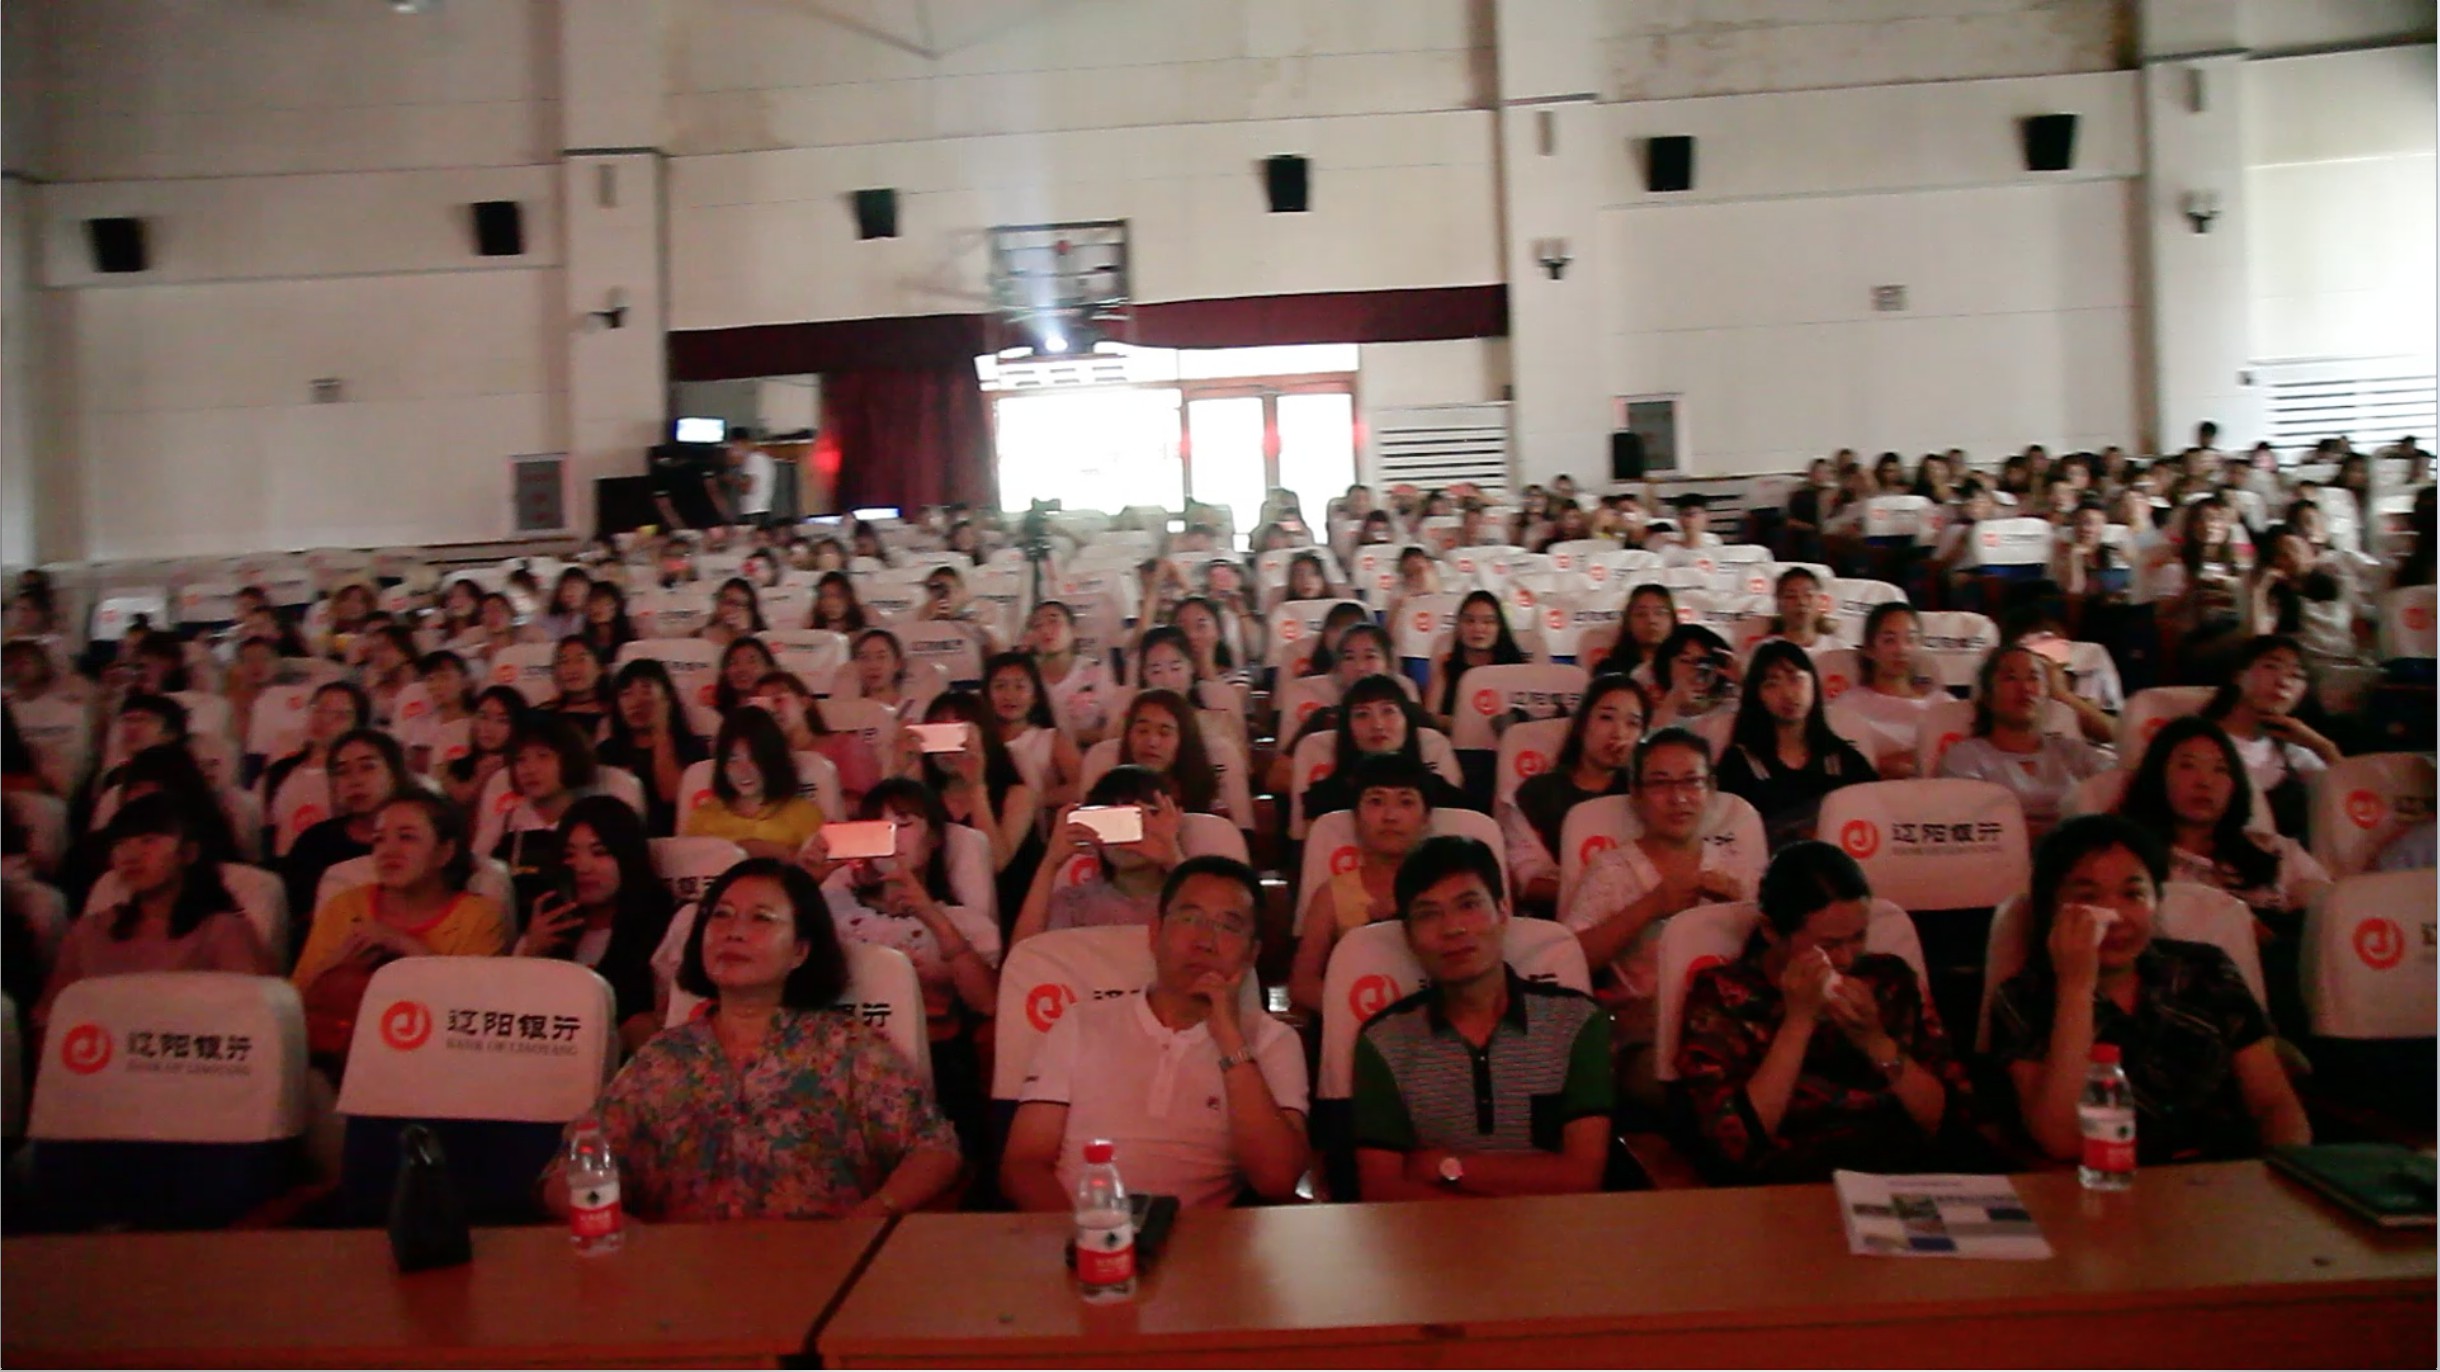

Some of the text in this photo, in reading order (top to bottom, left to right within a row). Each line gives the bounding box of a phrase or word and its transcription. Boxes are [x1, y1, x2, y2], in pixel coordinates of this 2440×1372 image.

[448, 1010, 581, 1041] 辽阳银行
[127, 1032, 253, 1061] 辽阳银行
